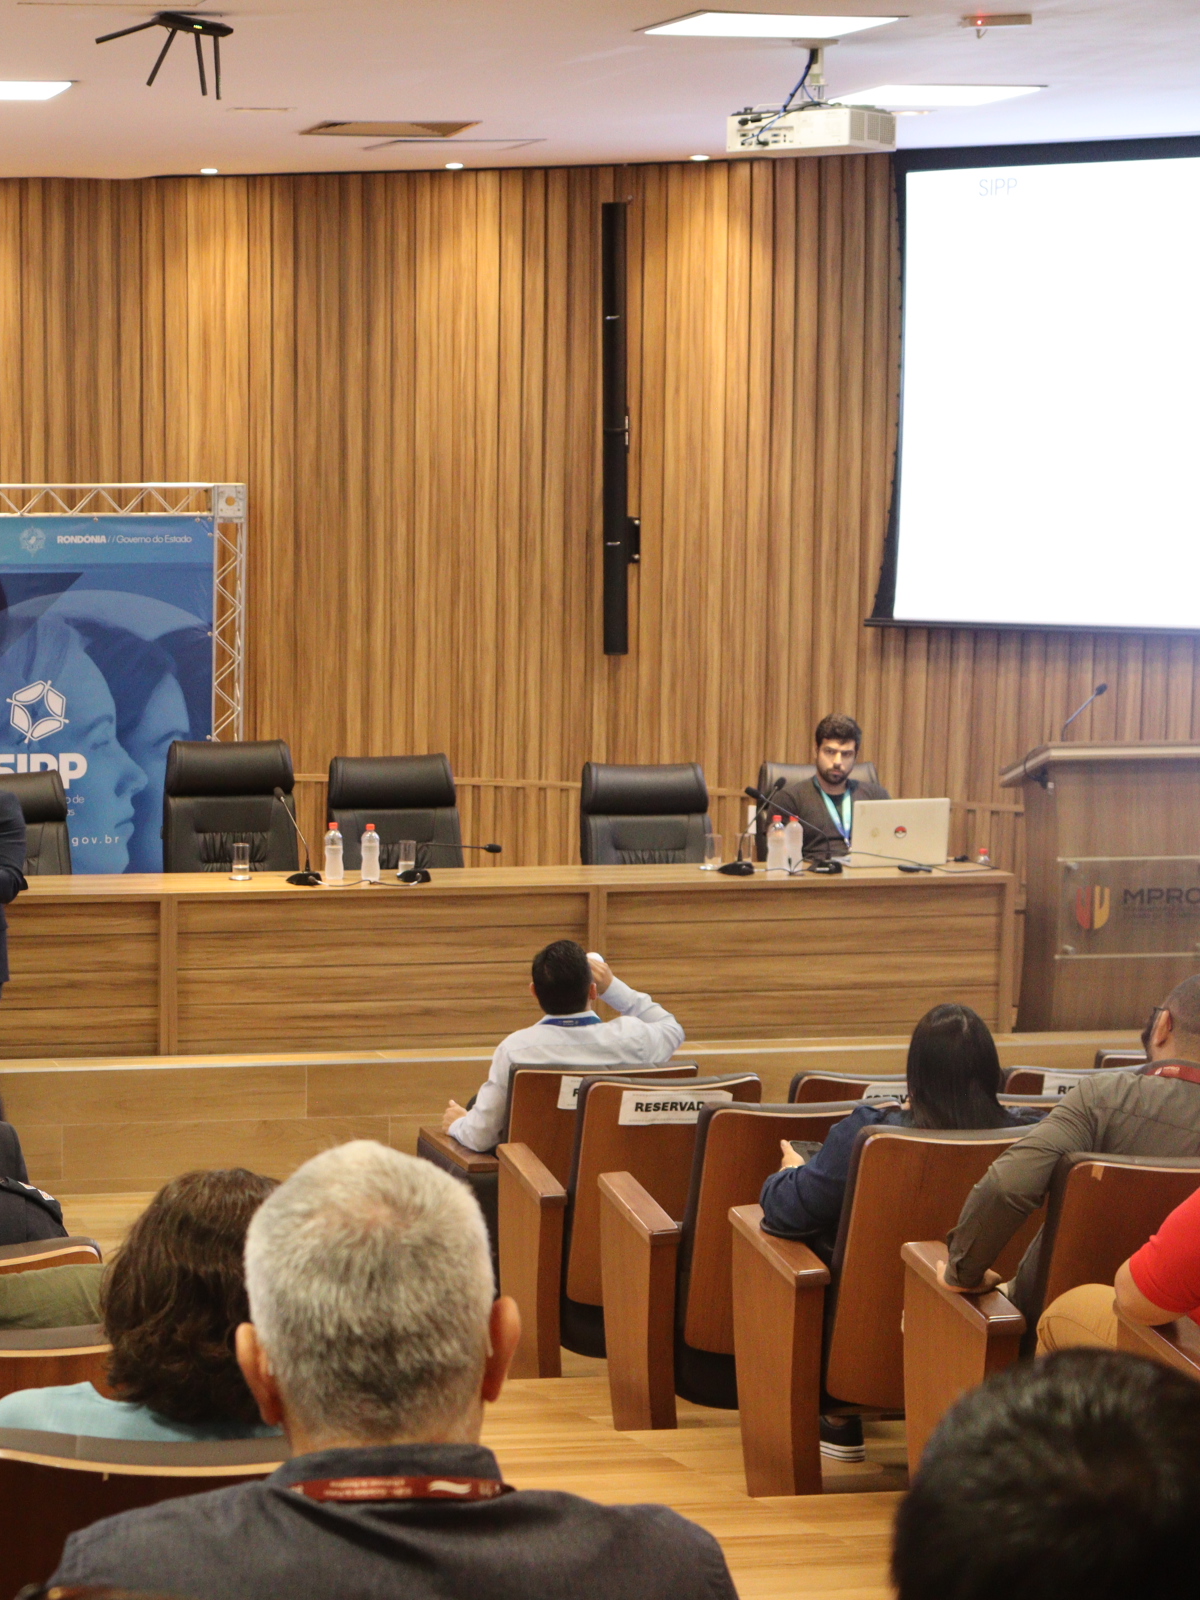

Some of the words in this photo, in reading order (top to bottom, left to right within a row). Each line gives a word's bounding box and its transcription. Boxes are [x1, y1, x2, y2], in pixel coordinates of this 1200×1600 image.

[978, 177, 1018, 197] SIPP
[117, 534, 151, 544] Governo
[152, 534, 163, 544] do
[164, 534, 193, 544] Estado
[72, 794, 85, 804] de
[71, 834, 119, 847] gov.br
[1123, 887, 1200, 904] MPRO
[634, 1101, 705, 1112] RESERVAD
